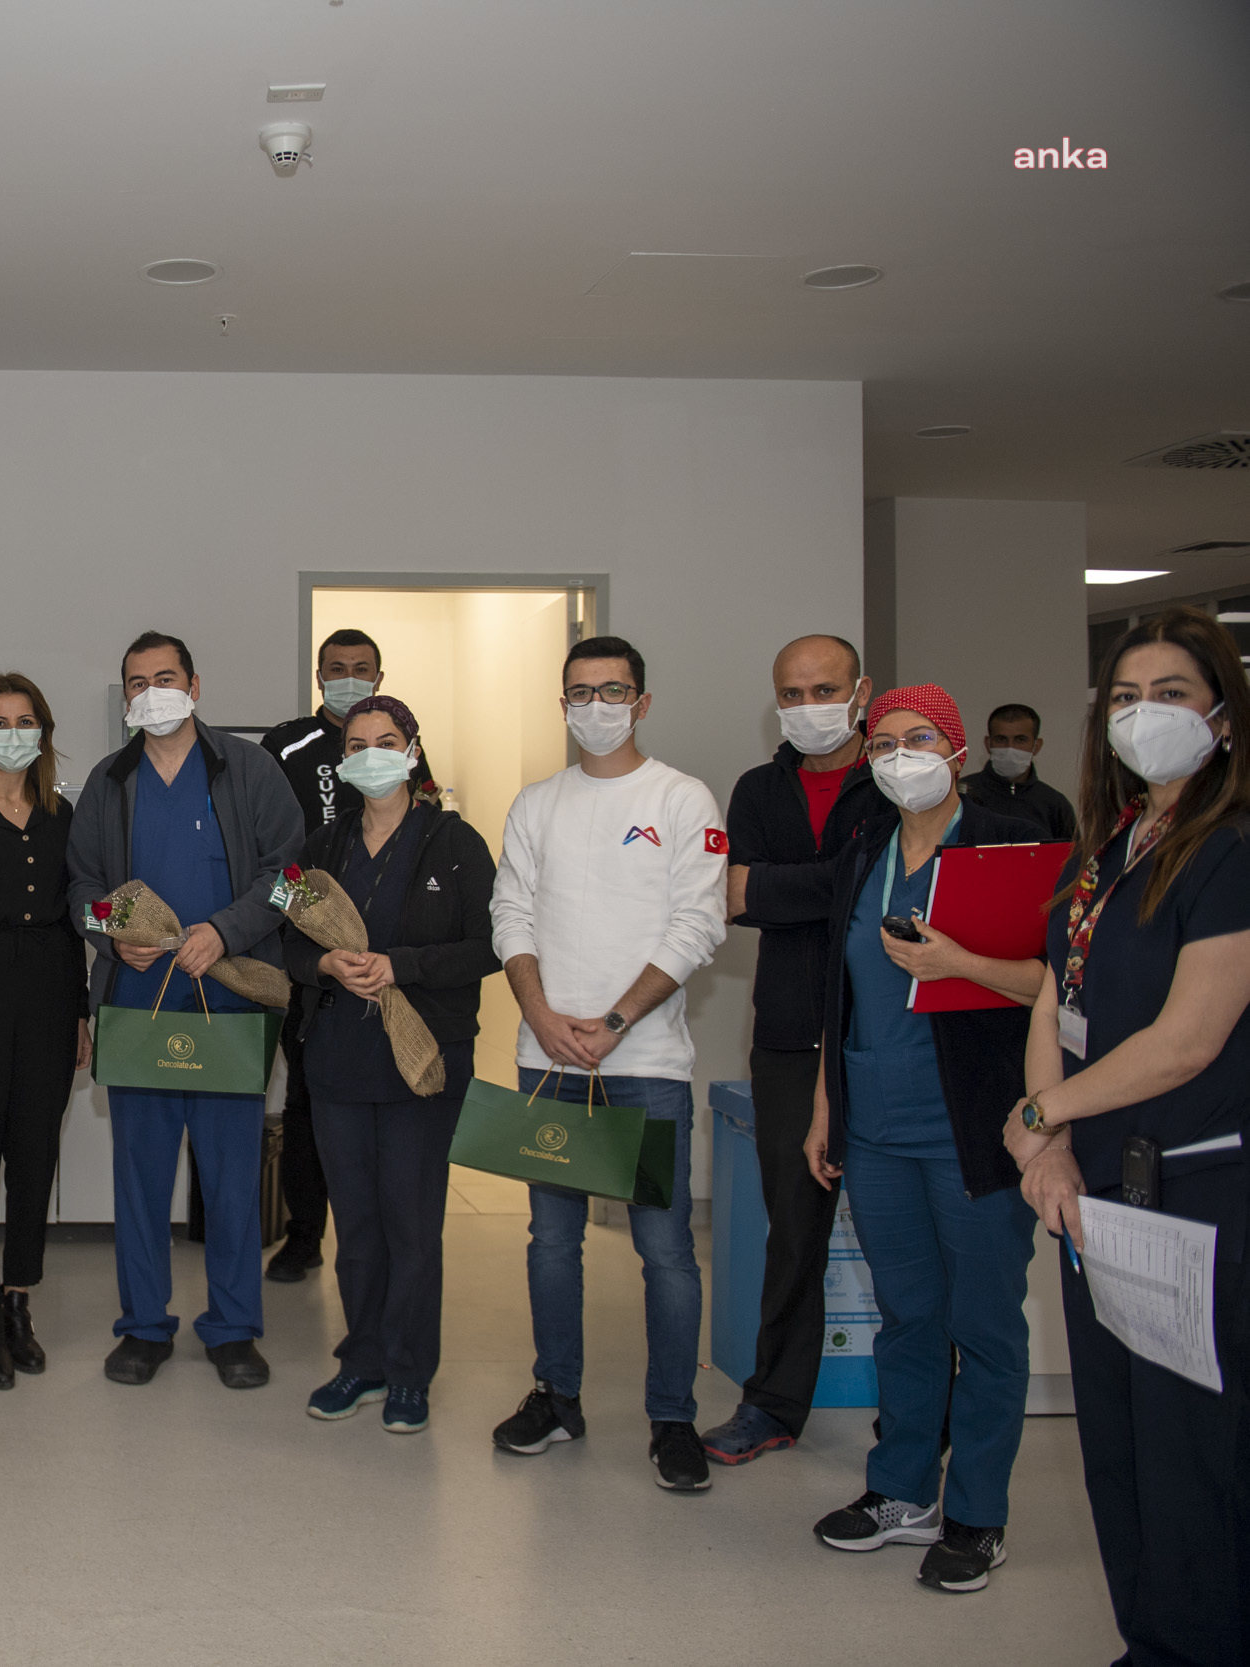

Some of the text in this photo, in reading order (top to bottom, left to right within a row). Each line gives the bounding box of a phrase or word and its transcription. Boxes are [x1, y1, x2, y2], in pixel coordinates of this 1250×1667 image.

[316, 764, 336, 825] GÜVE
[269, 885, 288, 906] TIP
[86, 915, 101, 929] TIP
[157, 1059, 190, 1069] Chocolate
